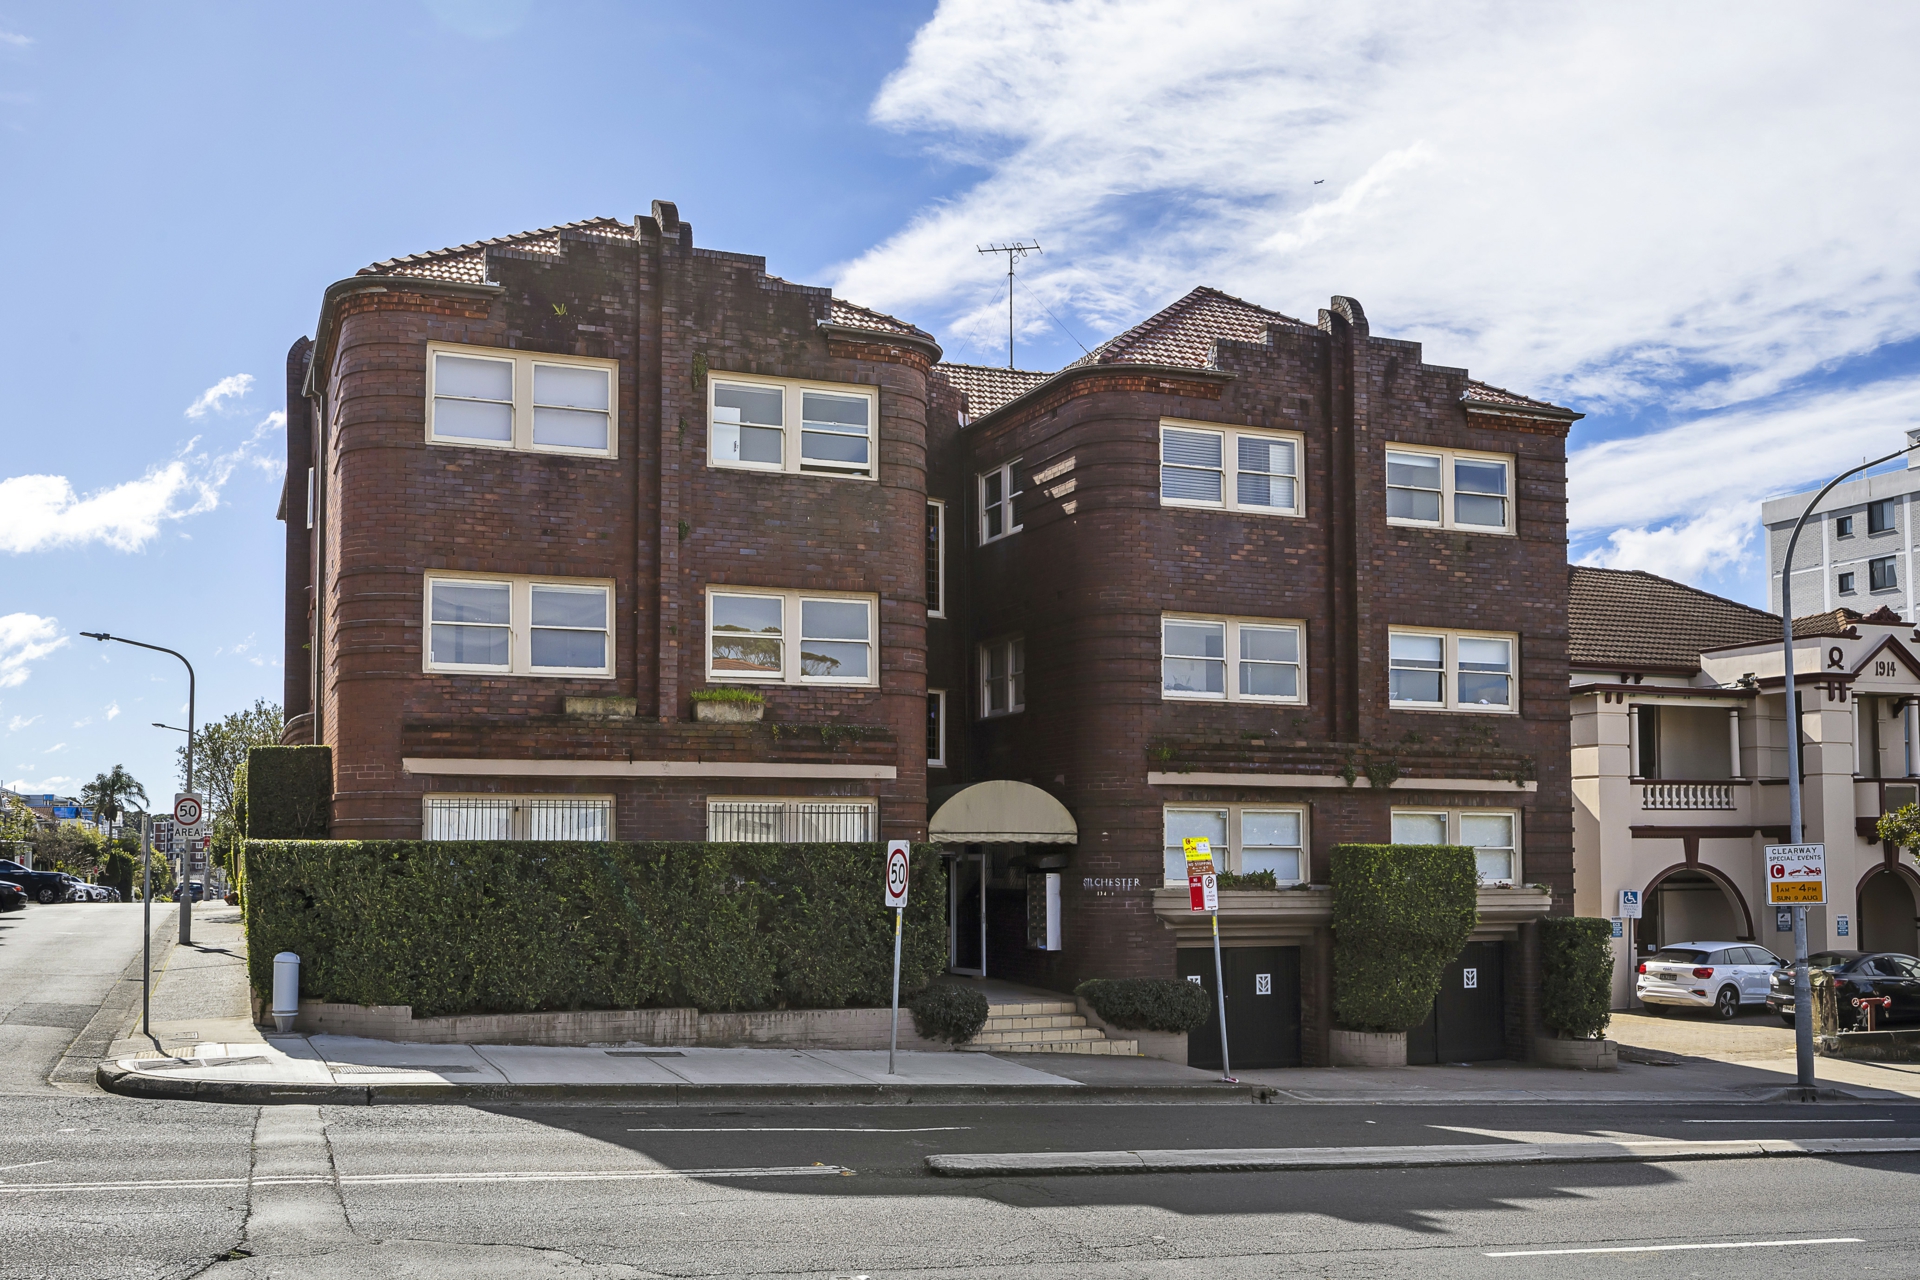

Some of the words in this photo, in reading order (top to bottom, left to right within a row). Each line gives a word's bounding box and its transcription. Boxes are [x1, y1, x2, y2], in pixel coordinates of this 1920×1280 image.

[1875, 661, 1896, 677] 1914
[179, 805, 197, 817] 50
[174, 828, 201, 836] AREA
[1771, 847, 1817, 855] CLEARWAY
[891, 862, 905, 884] 50
